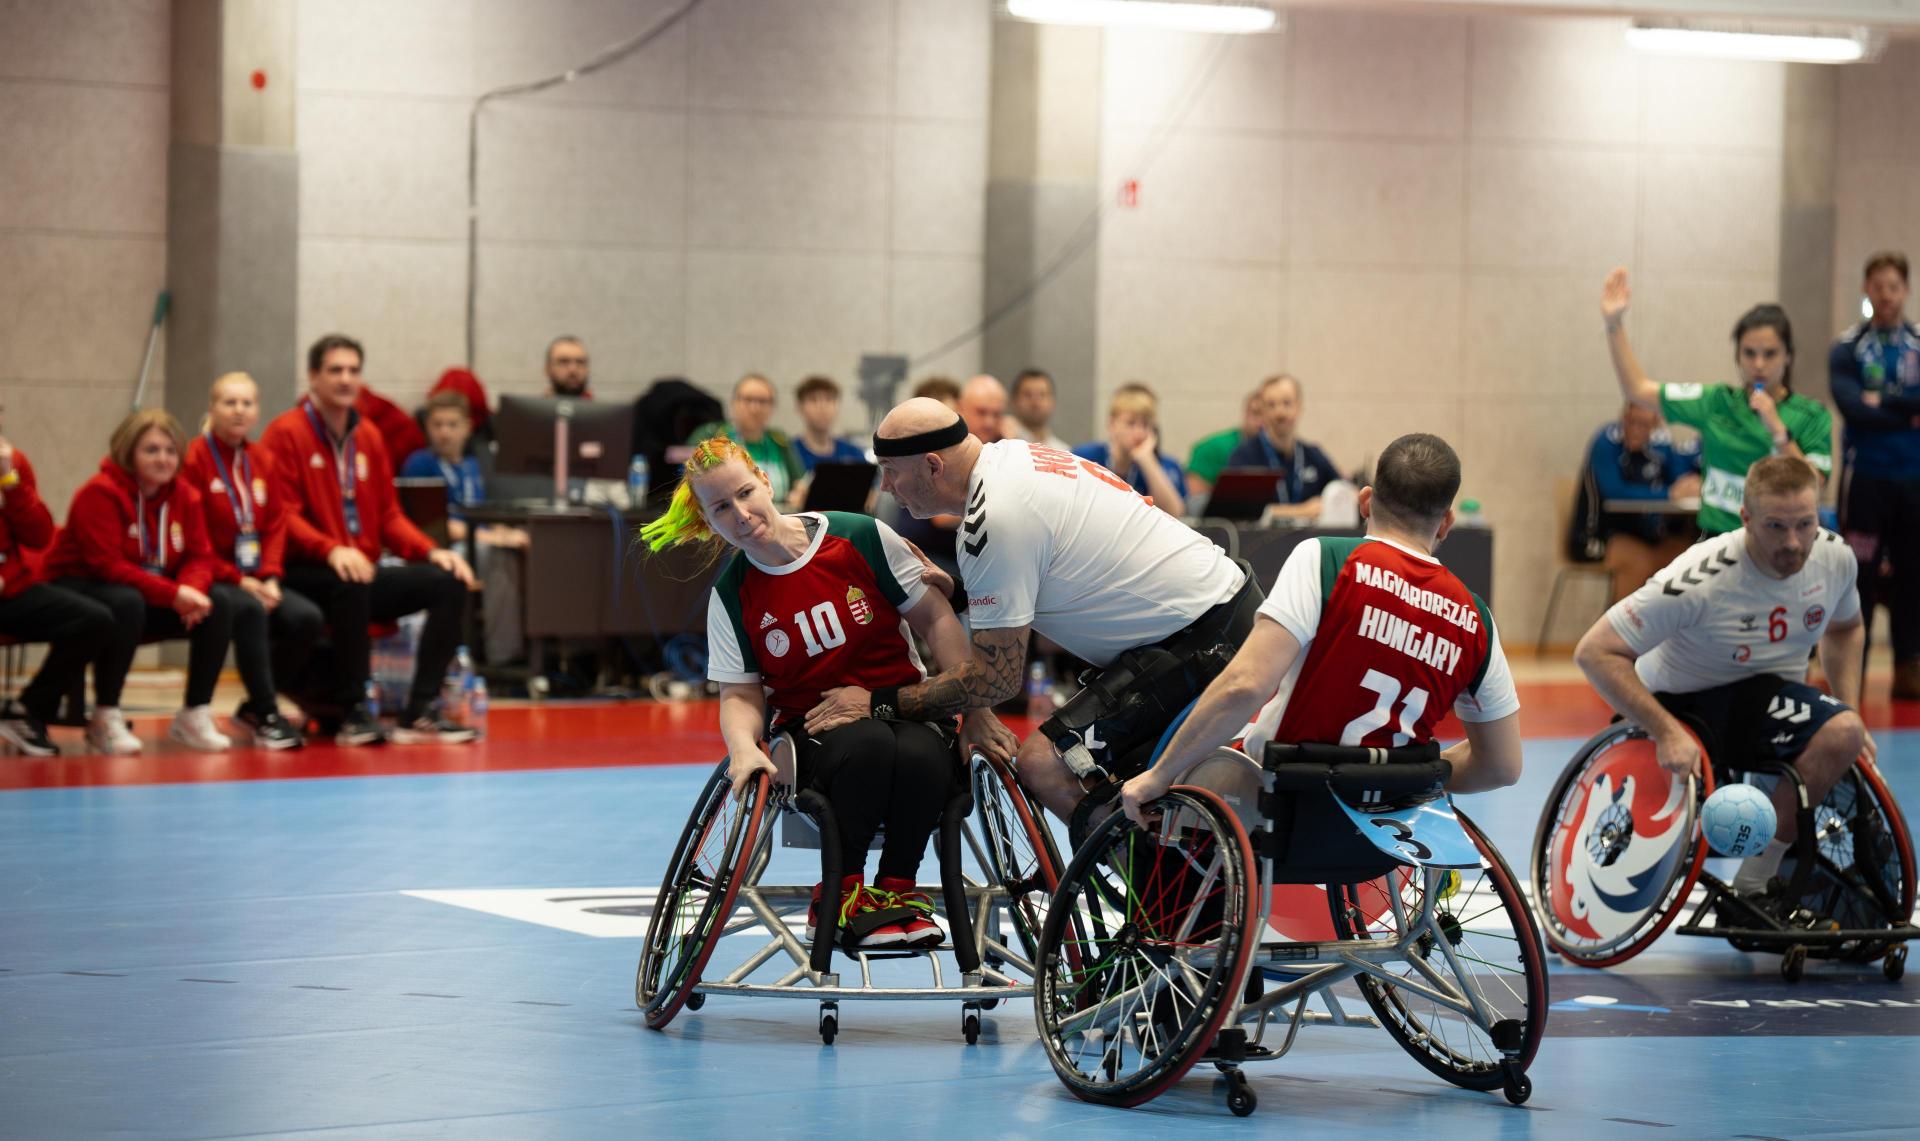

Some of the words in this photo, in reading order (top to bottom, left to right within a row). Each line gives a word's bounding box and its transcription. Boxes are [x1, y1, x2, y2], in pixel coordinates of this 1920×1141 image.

[793, 600, 847, 658] 10
[1355, 561, 1479, 634] MAGYARORSZÁG
[1768, 604, 1788, 643] 6
[1357, 604, 1463, 676] HUNGARY
[1338, 668, 1430, 748] 21
[1369, 817, 1433, 861] 3
